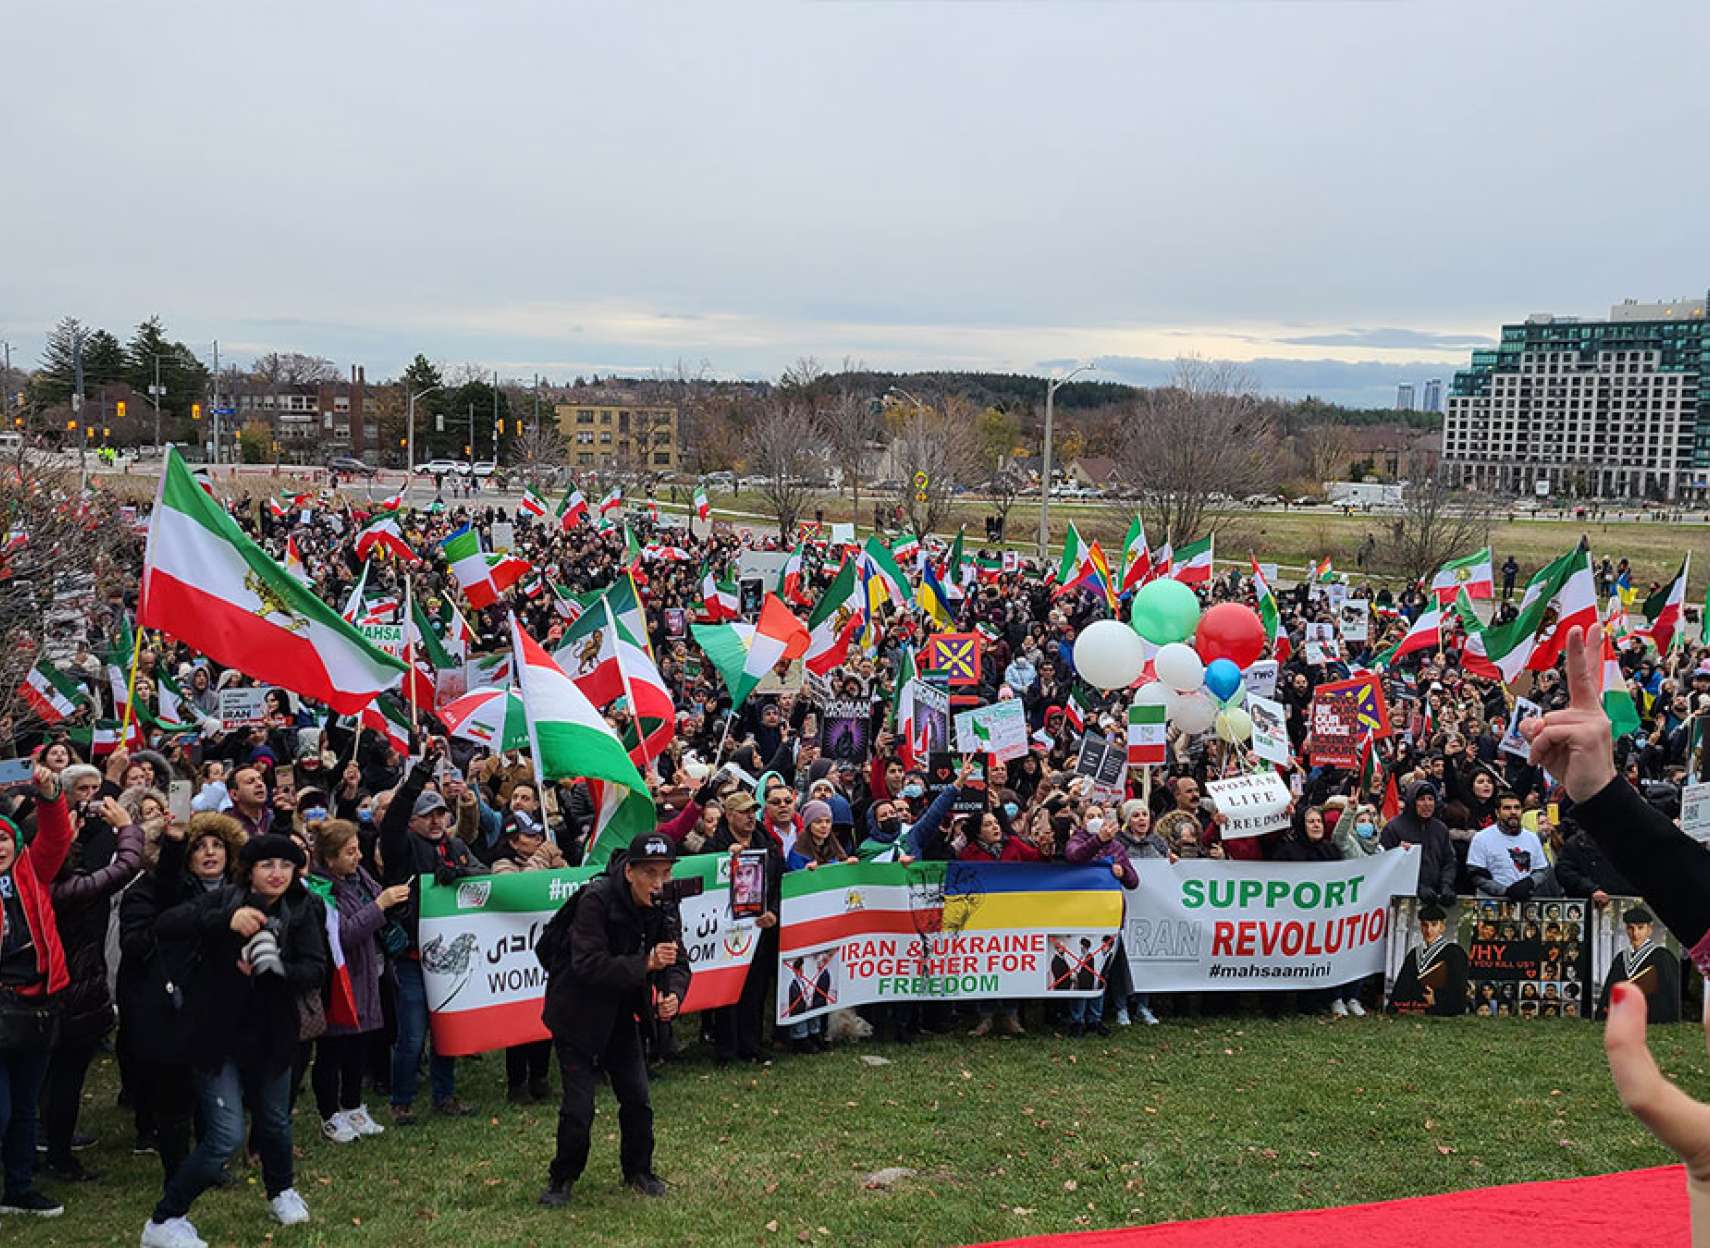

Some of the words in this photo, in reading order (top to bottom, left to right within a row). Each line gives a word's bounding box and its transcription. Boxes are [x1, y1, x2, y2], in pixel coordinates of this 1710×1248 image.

[1212, 777, 1276, 793] WOMAN
[1229, 791, 1276, 806] LIFE
[1225, 813, 1289, 831] FREEDOM
[1182, 875, 1365, 909] SUPPORT
[1128, 917, 1201, 957] RAN
[1211, 907, 1387, 957] REVOLUTIO
[840, 940, 897, 962] IRAN
[907, 940, 923, 958] &
[933, 934, 1045, 956] UKRAINE
[846, 957, 978, 980] TOGETHER
[987, 954, 1037, 973] FOR
[1209, 961, 1331, 978] #mahsaamini
[878, 975, 999, 995] FREEDOM
